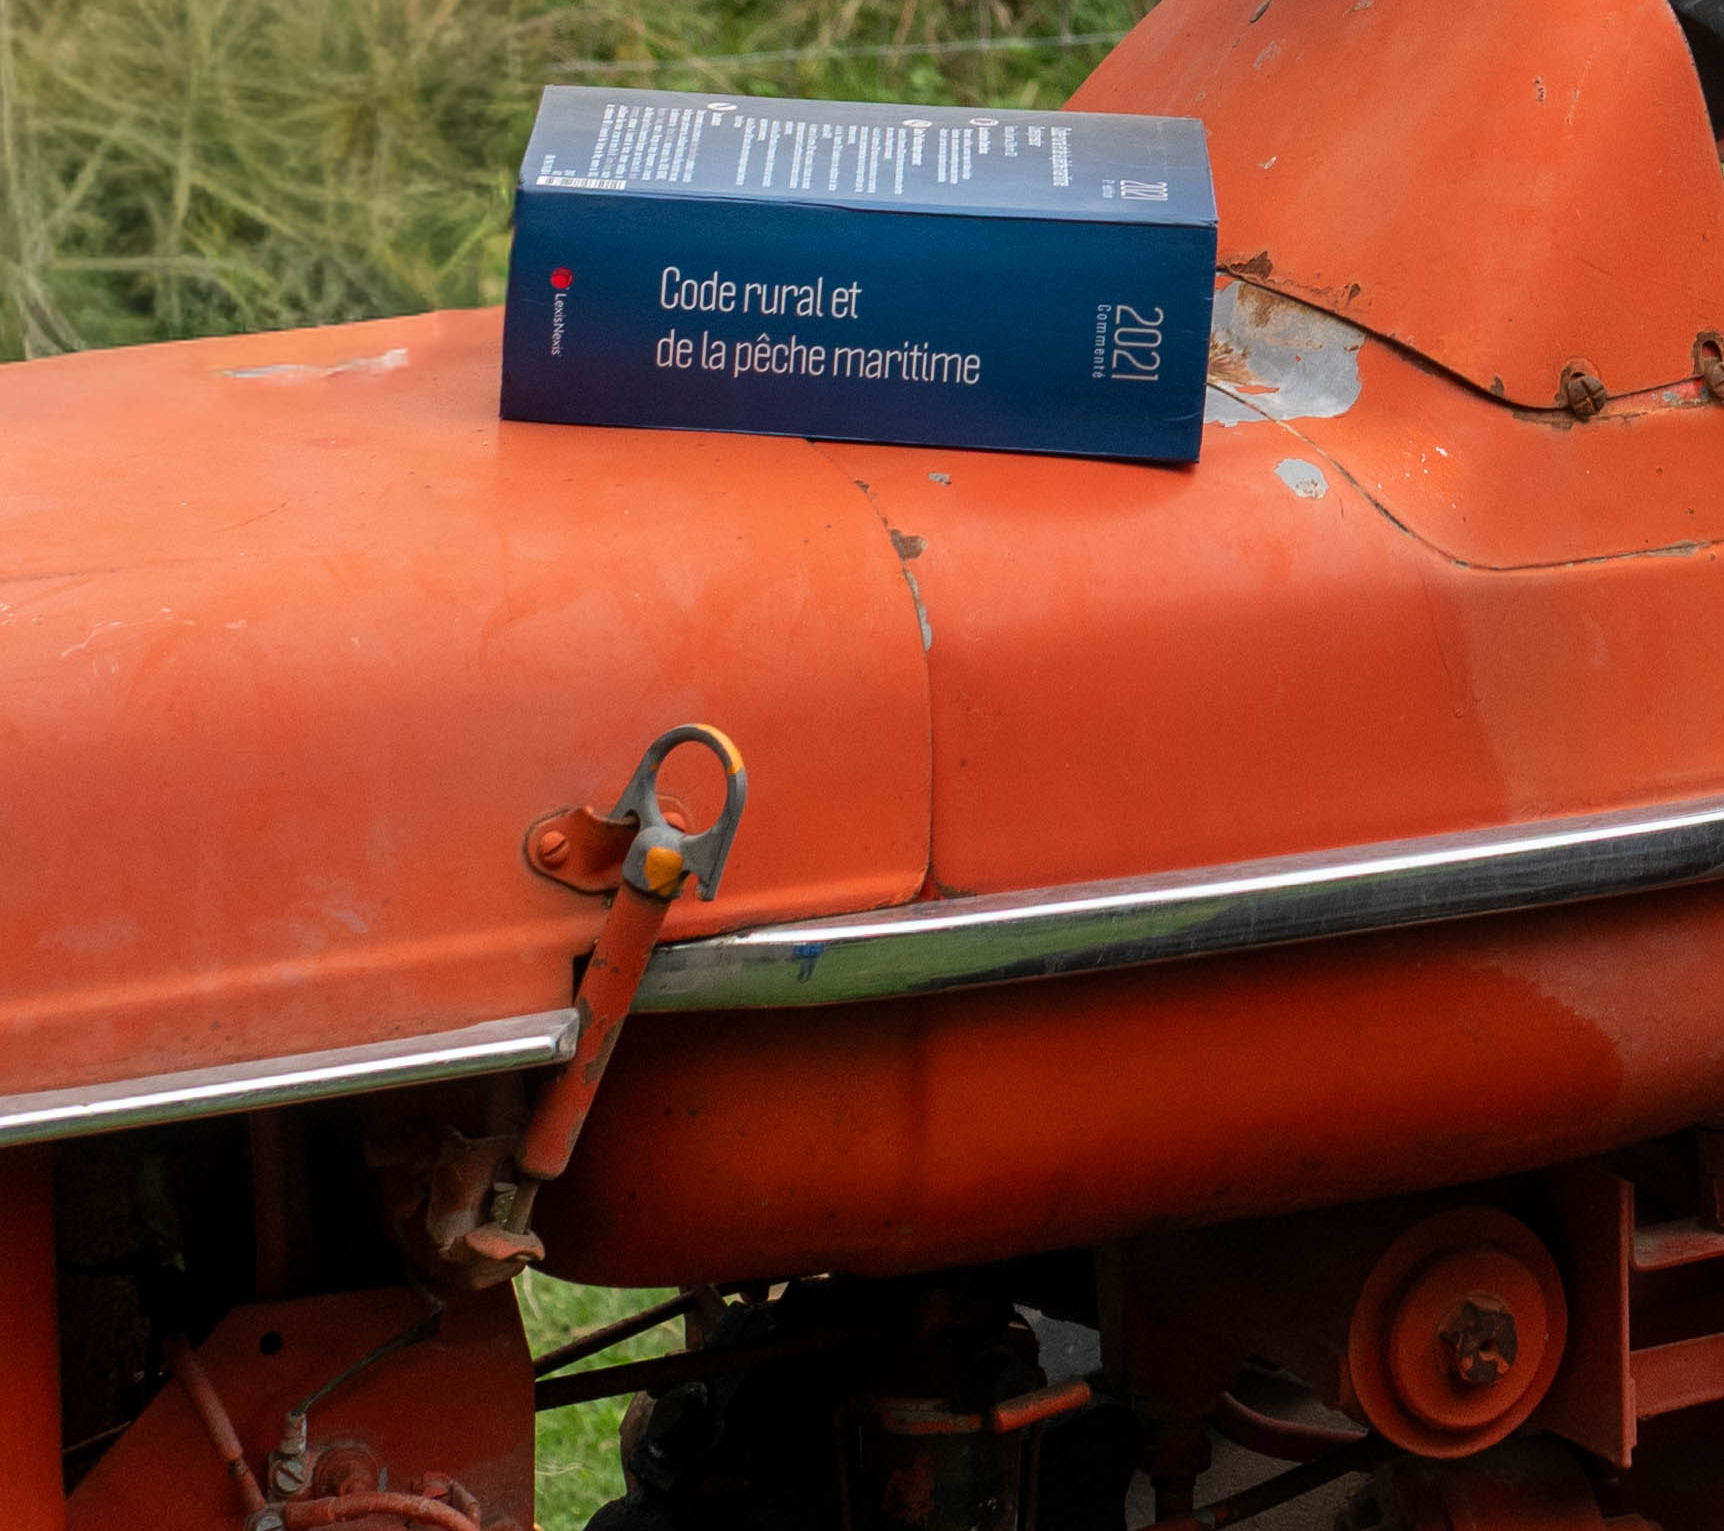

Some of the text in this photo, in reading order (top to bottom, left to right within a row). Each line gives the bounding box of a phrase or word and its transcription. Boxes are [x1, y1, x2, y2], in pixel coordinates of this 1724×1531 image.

[1120, 179, 1168, 201] 2021
[660, 266, 862, 319] Code rural et
[551, 292, 568, 356] LexisNexis
[1091, 304, 1112, 379] Commenté
[1111, 305, 1164, 381] 2021
[656, 328, 981, 385] de la pêche maritime
